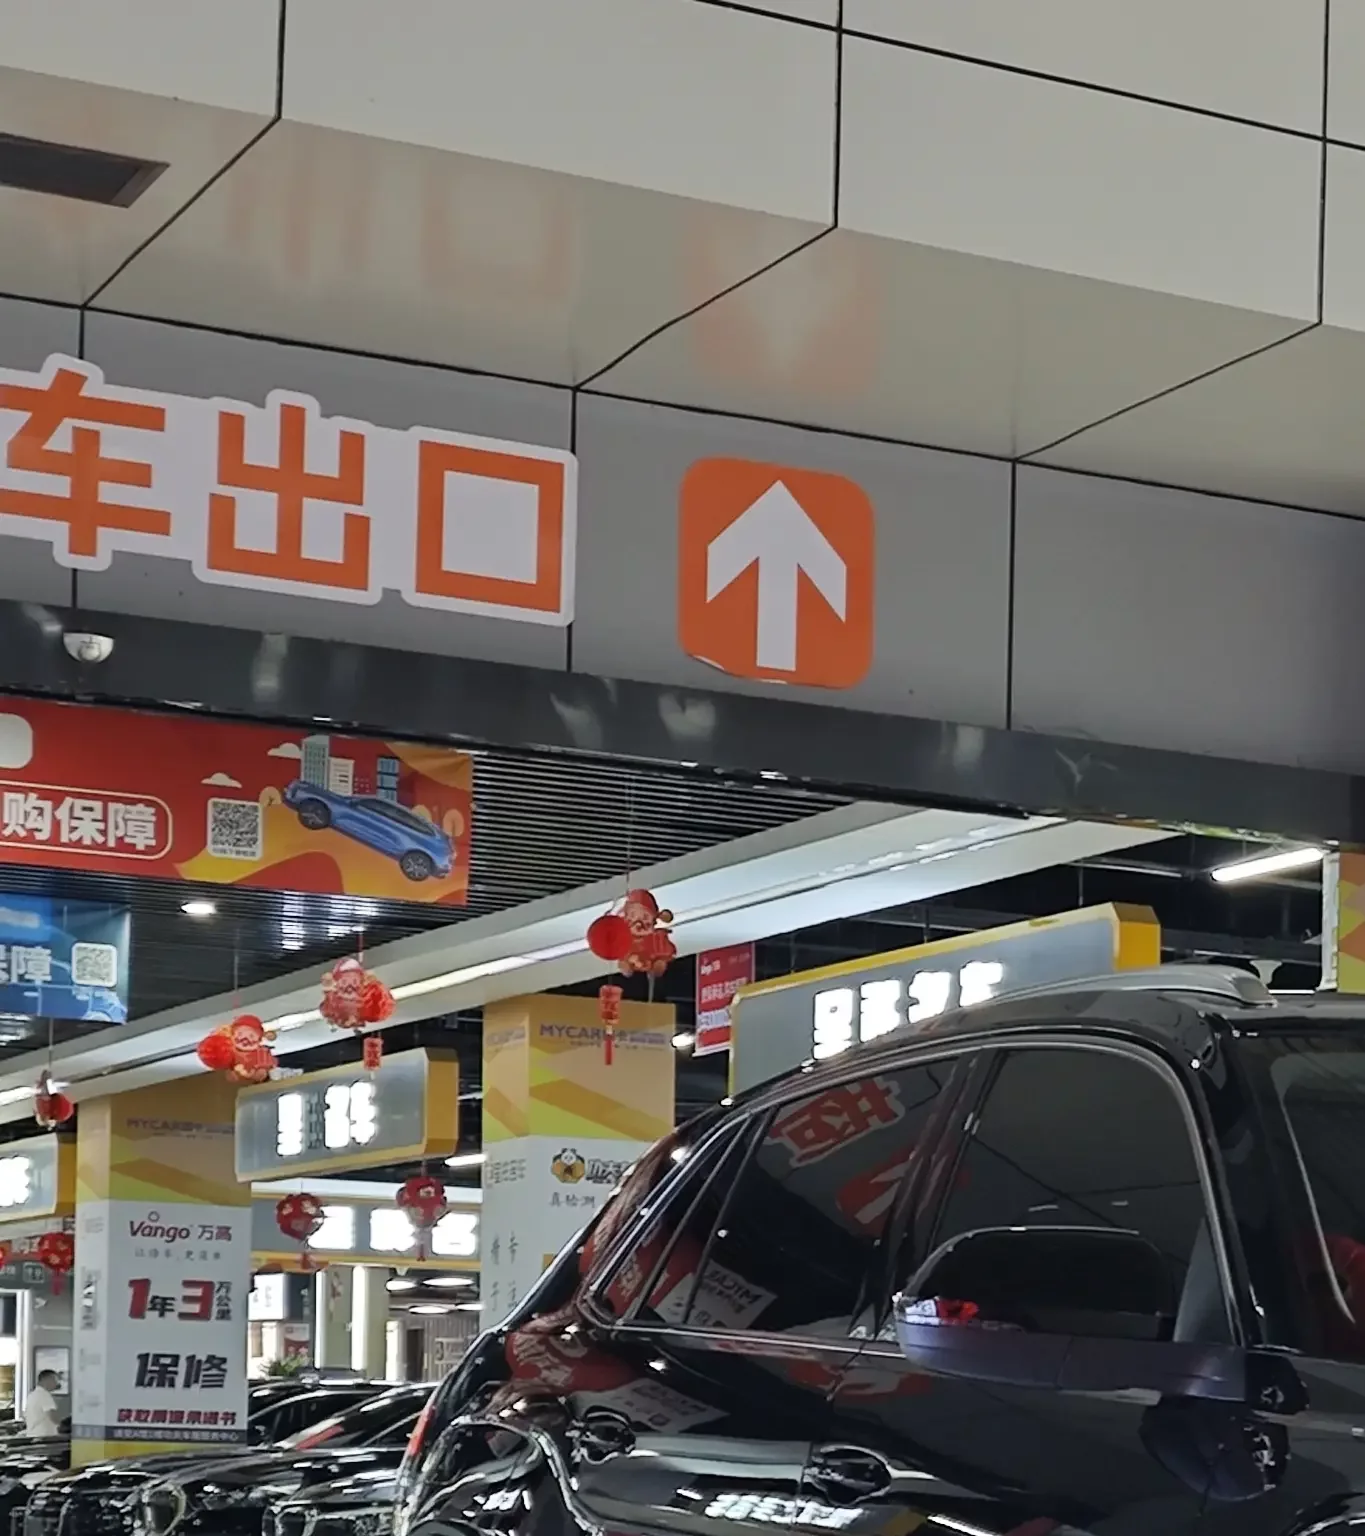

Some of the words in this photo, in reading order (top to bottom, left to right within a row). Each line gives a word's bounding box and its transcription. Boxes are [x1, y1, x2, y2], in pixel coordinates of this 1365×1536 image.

[0, 367, 566, 615] 车出口
[1, 791, 158, 850] 购保障
[129, 1219, 191, 1243] Vango
[135, 1352, 229, 1389] 保修
